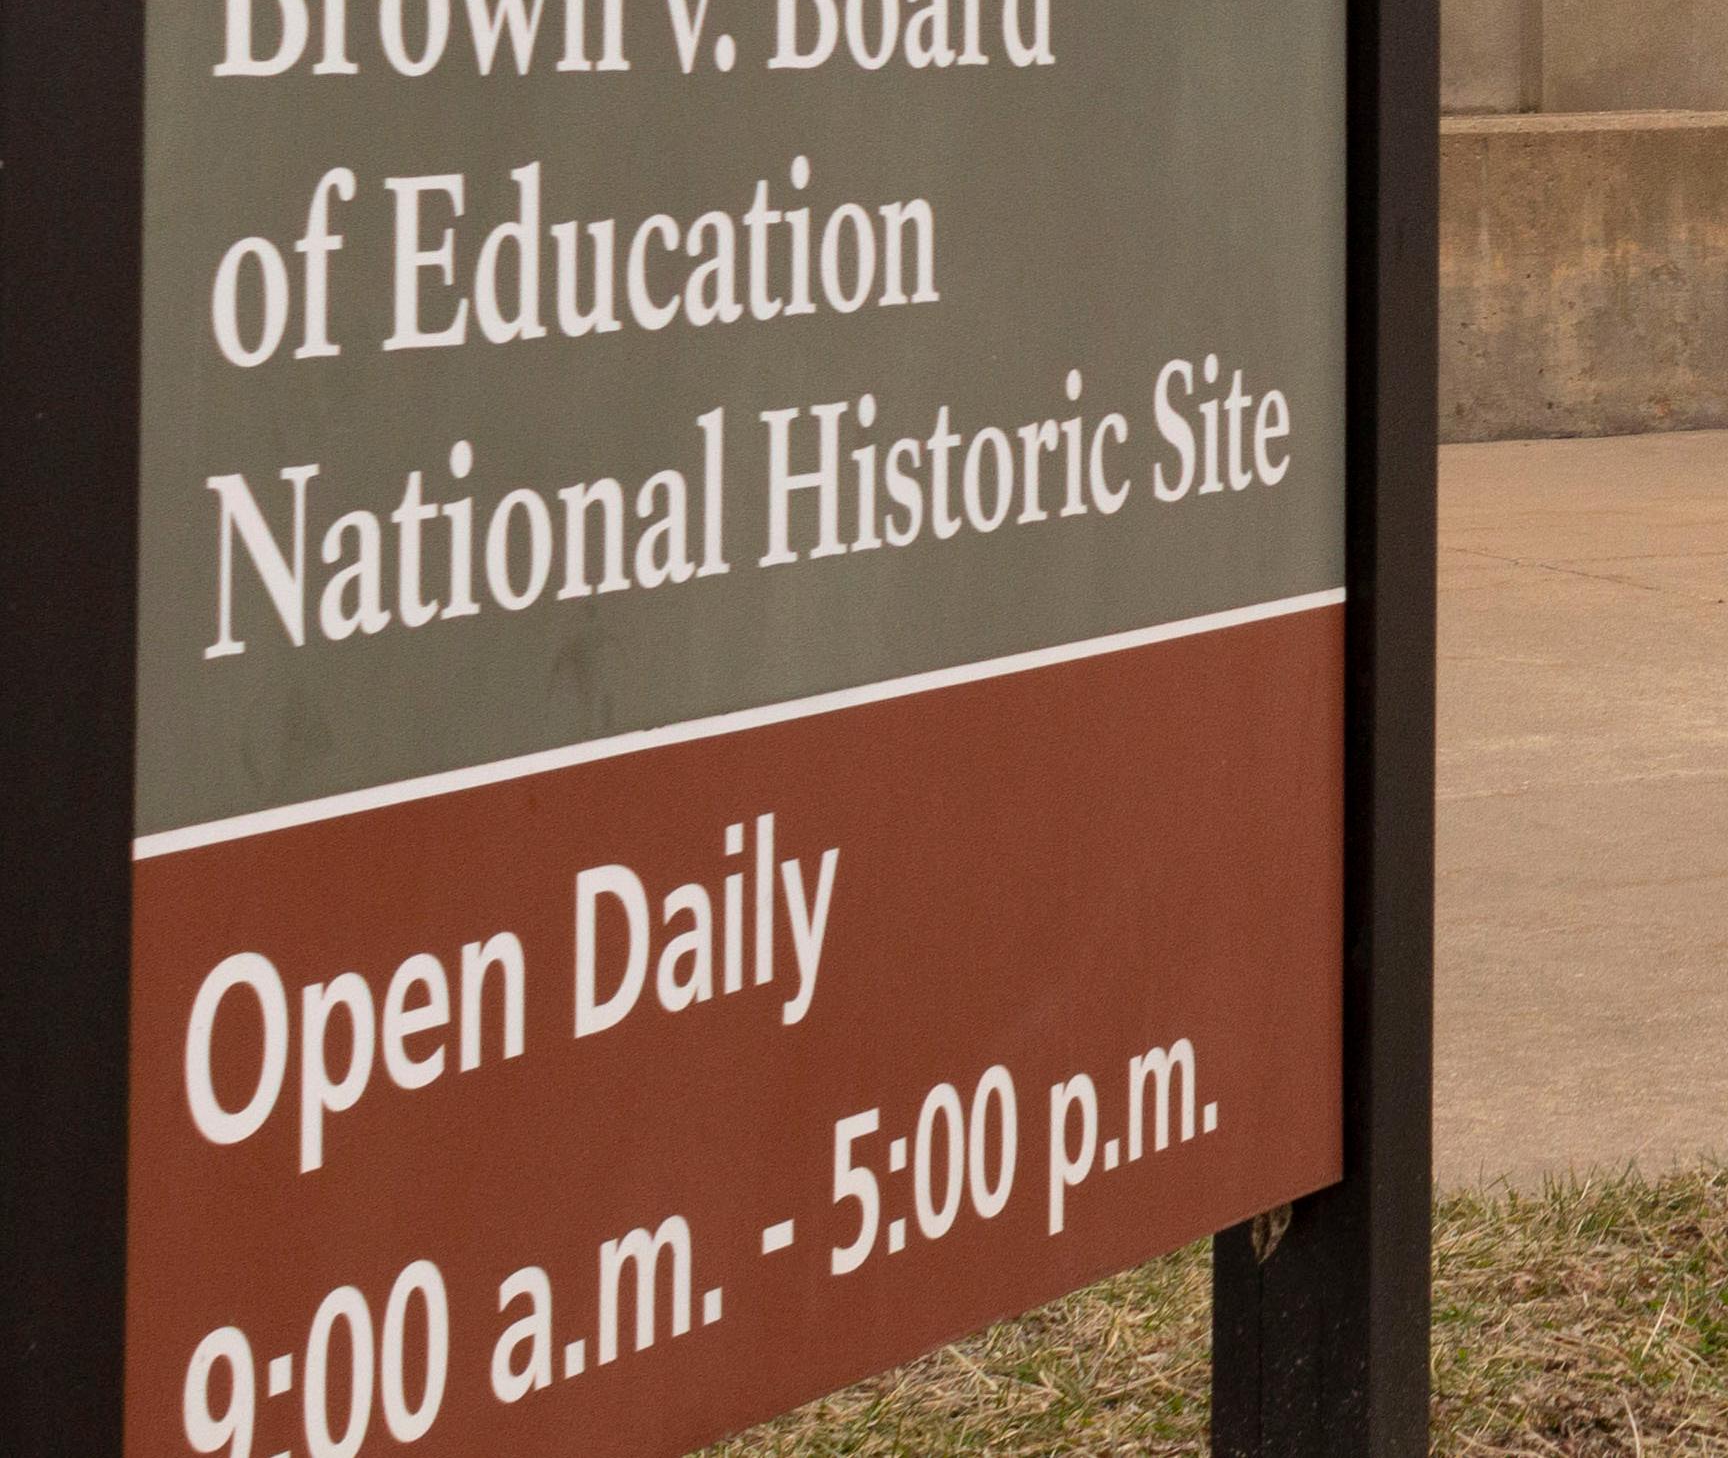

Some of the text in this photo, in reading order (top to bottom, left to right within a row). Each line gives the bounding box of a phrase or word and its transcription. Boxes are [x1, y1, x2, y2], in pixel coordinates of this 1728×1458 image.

[210, 153, 942, 370] of Education
[203, 352, 1292, 662] National Historic Site
[184, 812, 840, 1175] Open Daily
[183, 1259, 449, 1458] 9:00
[490, 1214, 723, 1404] a.m.
[831, 1064, 1018, 1276] 5:00
[1048, 1037, 1220, 1236] p.m.
